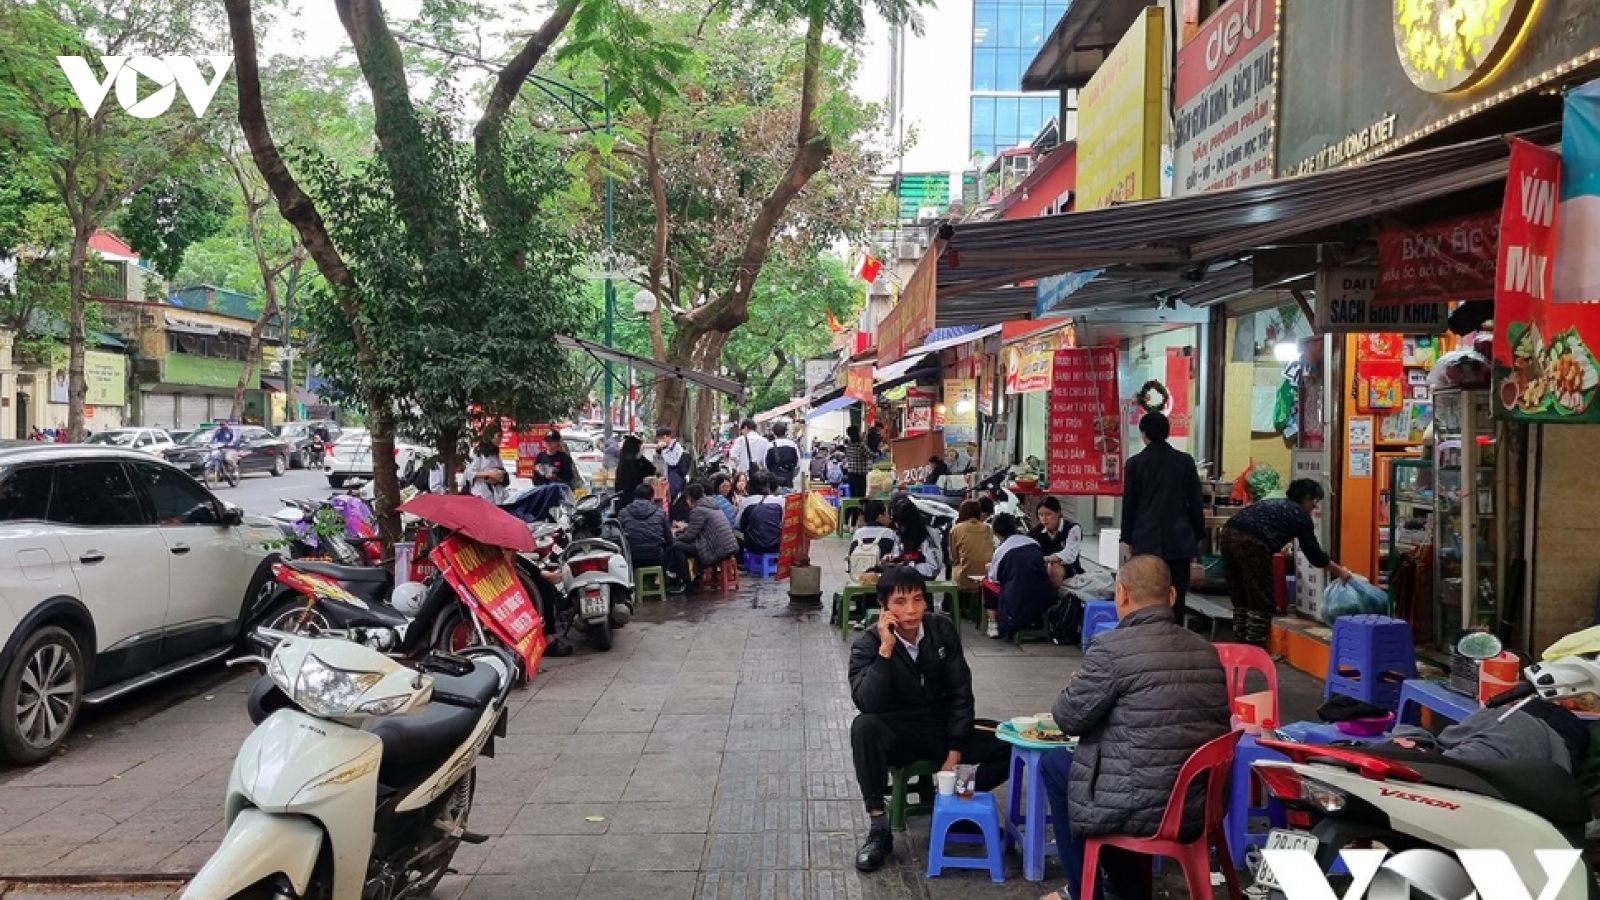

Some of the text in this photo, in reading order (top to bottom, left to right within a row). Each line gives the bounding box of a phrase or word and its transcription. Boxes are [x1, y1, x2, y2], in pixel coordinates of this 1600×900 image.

[1205, 0, 1261, 70] deli
[1328, 127, 1369, 166] THƯỜNG
[1370, 111, 1396, 146] KIỆT
[1343, 278, 1366, 293] ĐẠI
[1331, 296, 1365, 324] SÁCH
[1379, 787, 1461, 810] VISION
